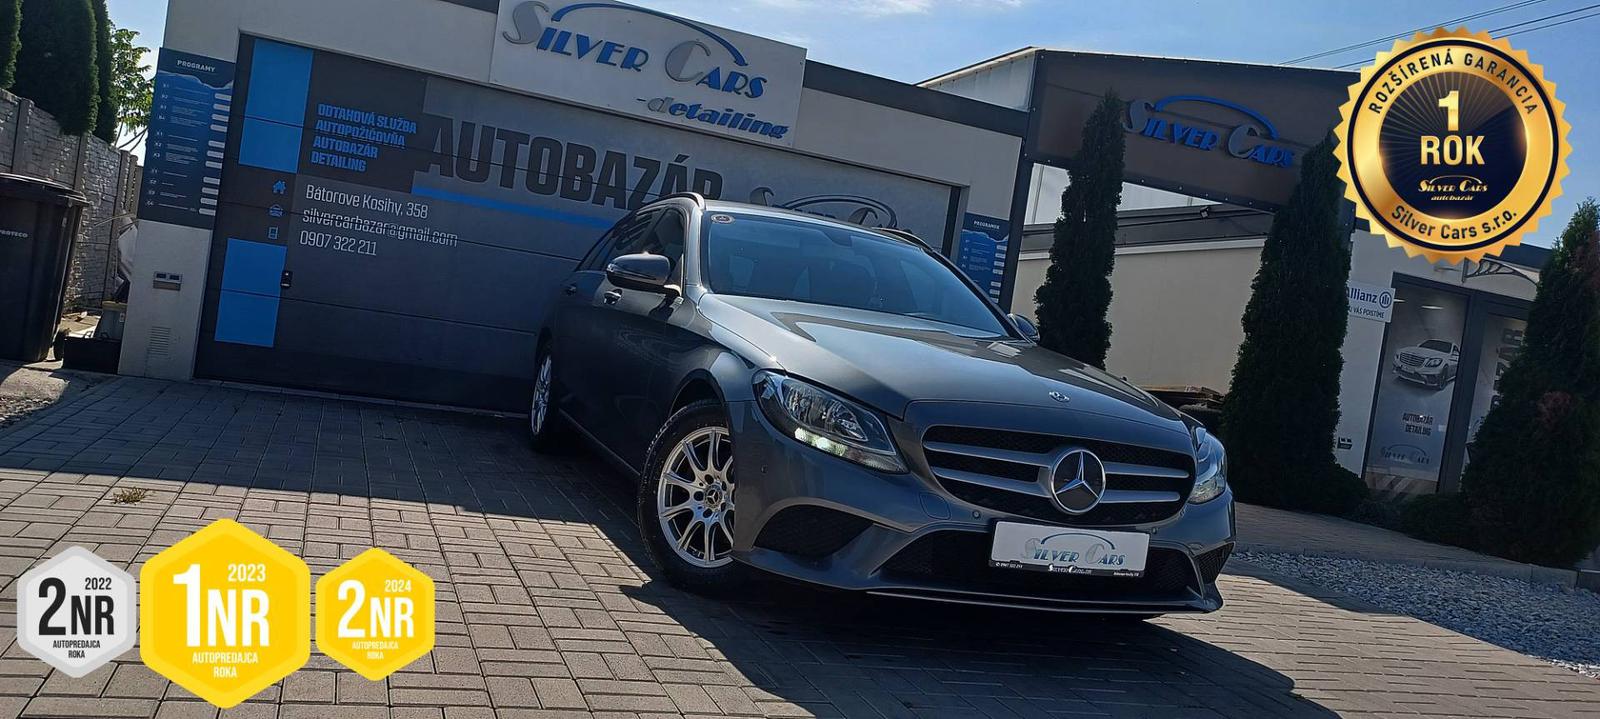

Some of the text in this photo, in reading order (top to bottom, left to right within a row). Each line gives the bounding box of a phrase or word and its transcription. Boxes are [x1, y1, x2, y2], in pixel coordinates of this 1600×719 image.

[502, 1, 767, 99] SILVER CARS
[177, 60, 215, 72] PROGRAMY
[318, 104, 417, 134] ODTAHOVÁ SLUŽBA
[311, 151, 367, 172] DETAILING
[313, 135, 378, 159] AUTOBAZÁR
[427, 115, 723, 210] AUTOBAZÁR
[306, 184, 428, 219] Bátorove Kosihy, 358
[300, 230, 377, 256] 0907 322 211
[1020, 537, 1125, 566] SILVER CARS
